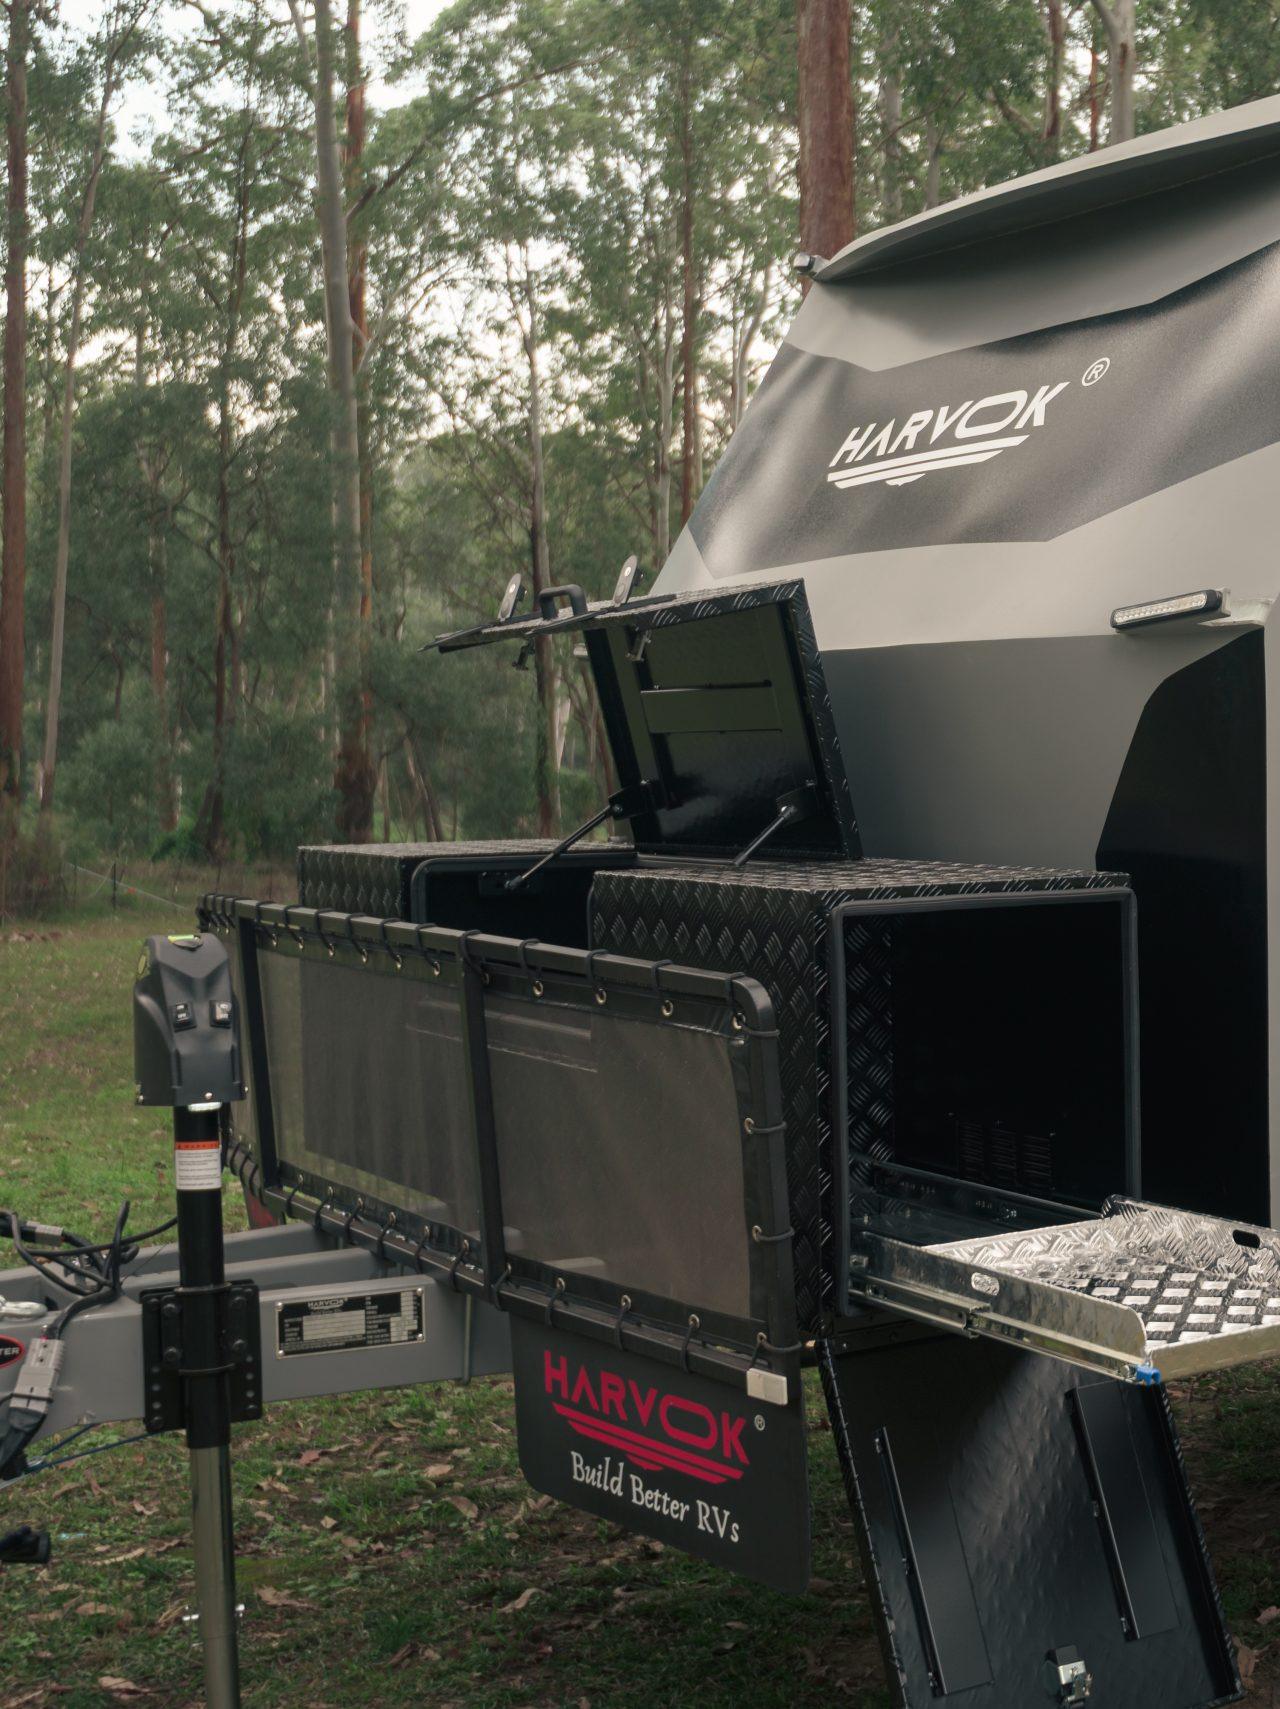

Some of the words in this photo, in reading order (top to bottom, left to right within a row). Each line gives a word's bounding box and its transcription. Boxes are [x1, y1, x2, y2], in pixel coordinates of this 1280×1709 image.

[828, 382, 1070, 468] HARVOK
[543, 1350, 750, 1466] HARVOK
[571, 1451, 624, 1498] Build
[630, 1474, 690, 1522] Better
[697, 1500, 740, 1543] RVs
